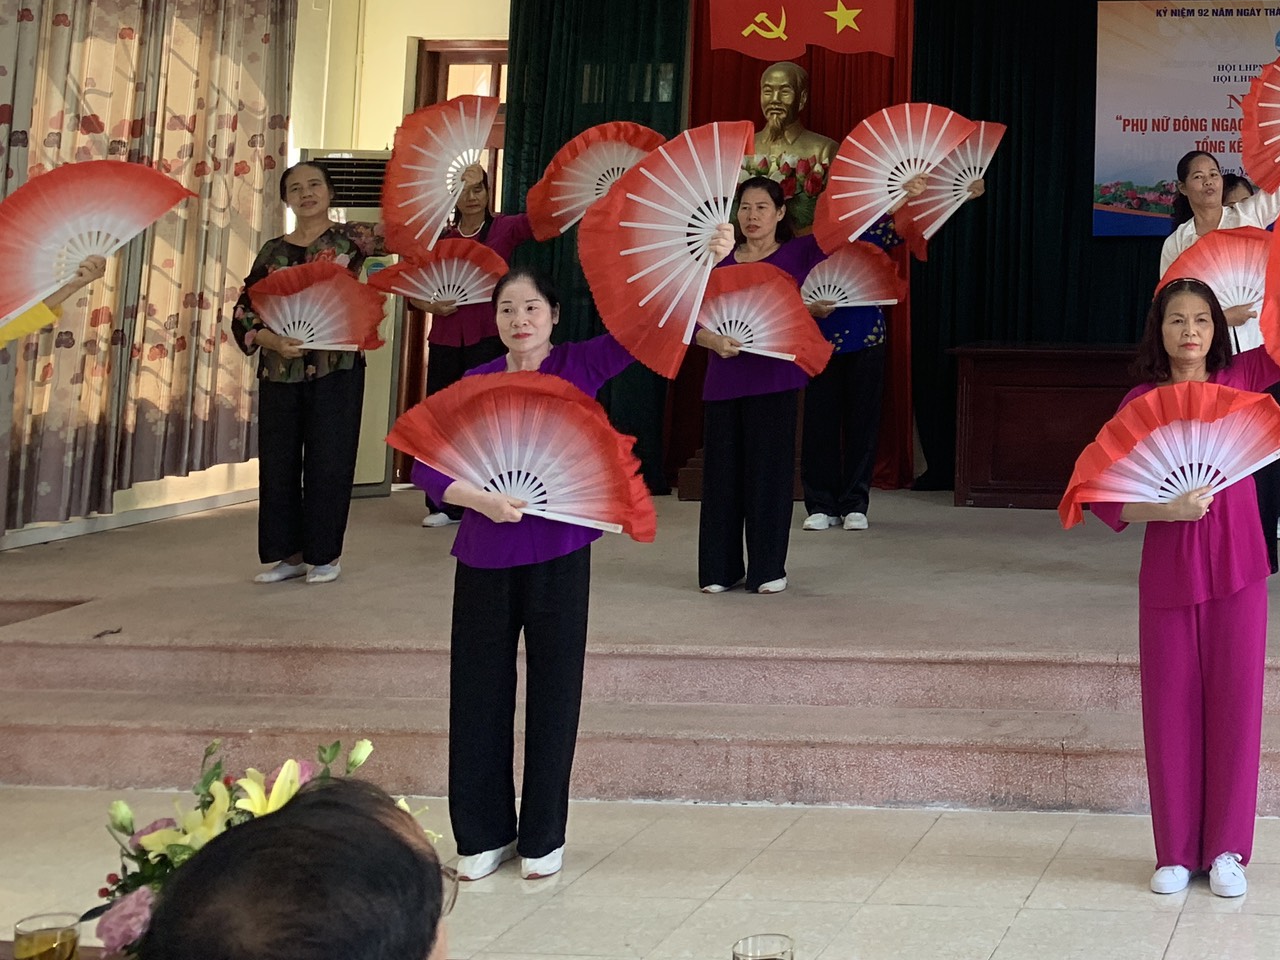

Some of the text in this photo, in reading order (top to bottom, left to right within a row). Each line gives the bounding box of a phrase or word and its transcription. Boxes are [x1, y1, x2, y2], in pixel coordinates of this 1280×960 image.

[1170, 7, 1195, 19] NIỆM
[1198, 8, 1209, 17] 92
[1212, 6, 1234, 17] NĂM
[1236, 7, 1261, 17] NGÀY
[1151, 115, 1170, 132] NỮ
[1173, 115, 1208, 132] ĐÔNG
[1195, 135, 1225, 154] TỔNG
